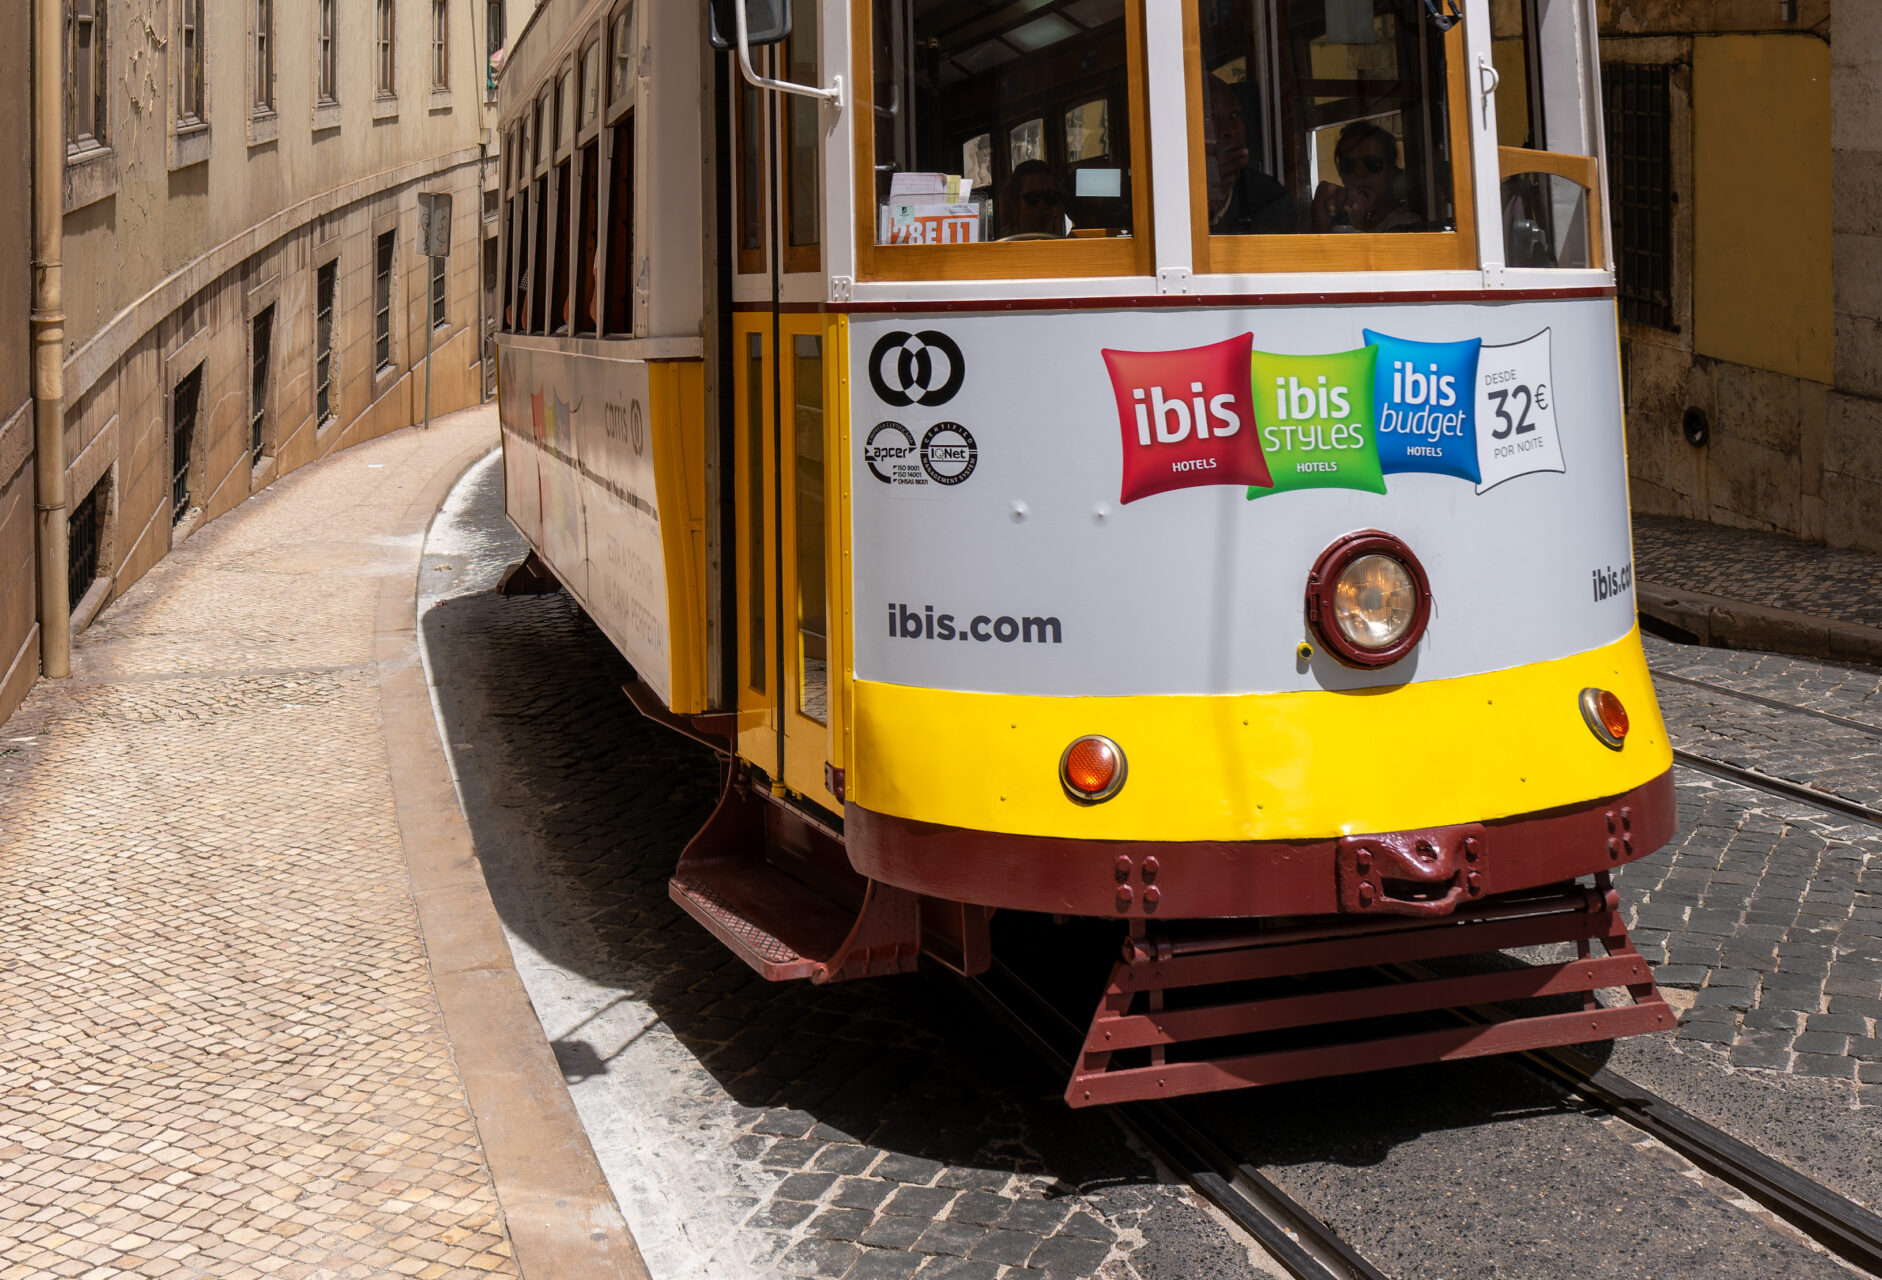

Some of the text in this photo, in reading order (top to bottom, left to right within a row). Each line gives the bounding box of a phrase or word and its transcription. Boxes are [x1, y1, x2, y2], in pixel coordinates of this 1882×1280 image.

[892, 220, 938, 244] 28E
[1393, 360, 1456, 406] ibis
[1484, 369, 1517, 386] DESDE
[1276, 375, 1351, 420] ibis
[1132, 381, 1241, 446] ibis
[1380, 402, 1466, 442] budget
[924, 423, 973, 444] CERTIFIED
[873, 447, 908, 462] apcer
[1407, 446, 1443, 457] HOTELS
[1494, 436, 1544, 459] POR NOITE
[1172, 458, 1217, 472] HOTELS
[1296, 461, 1337, 472] HOTELS
[888, 603, 1062, 643] ibis.com
